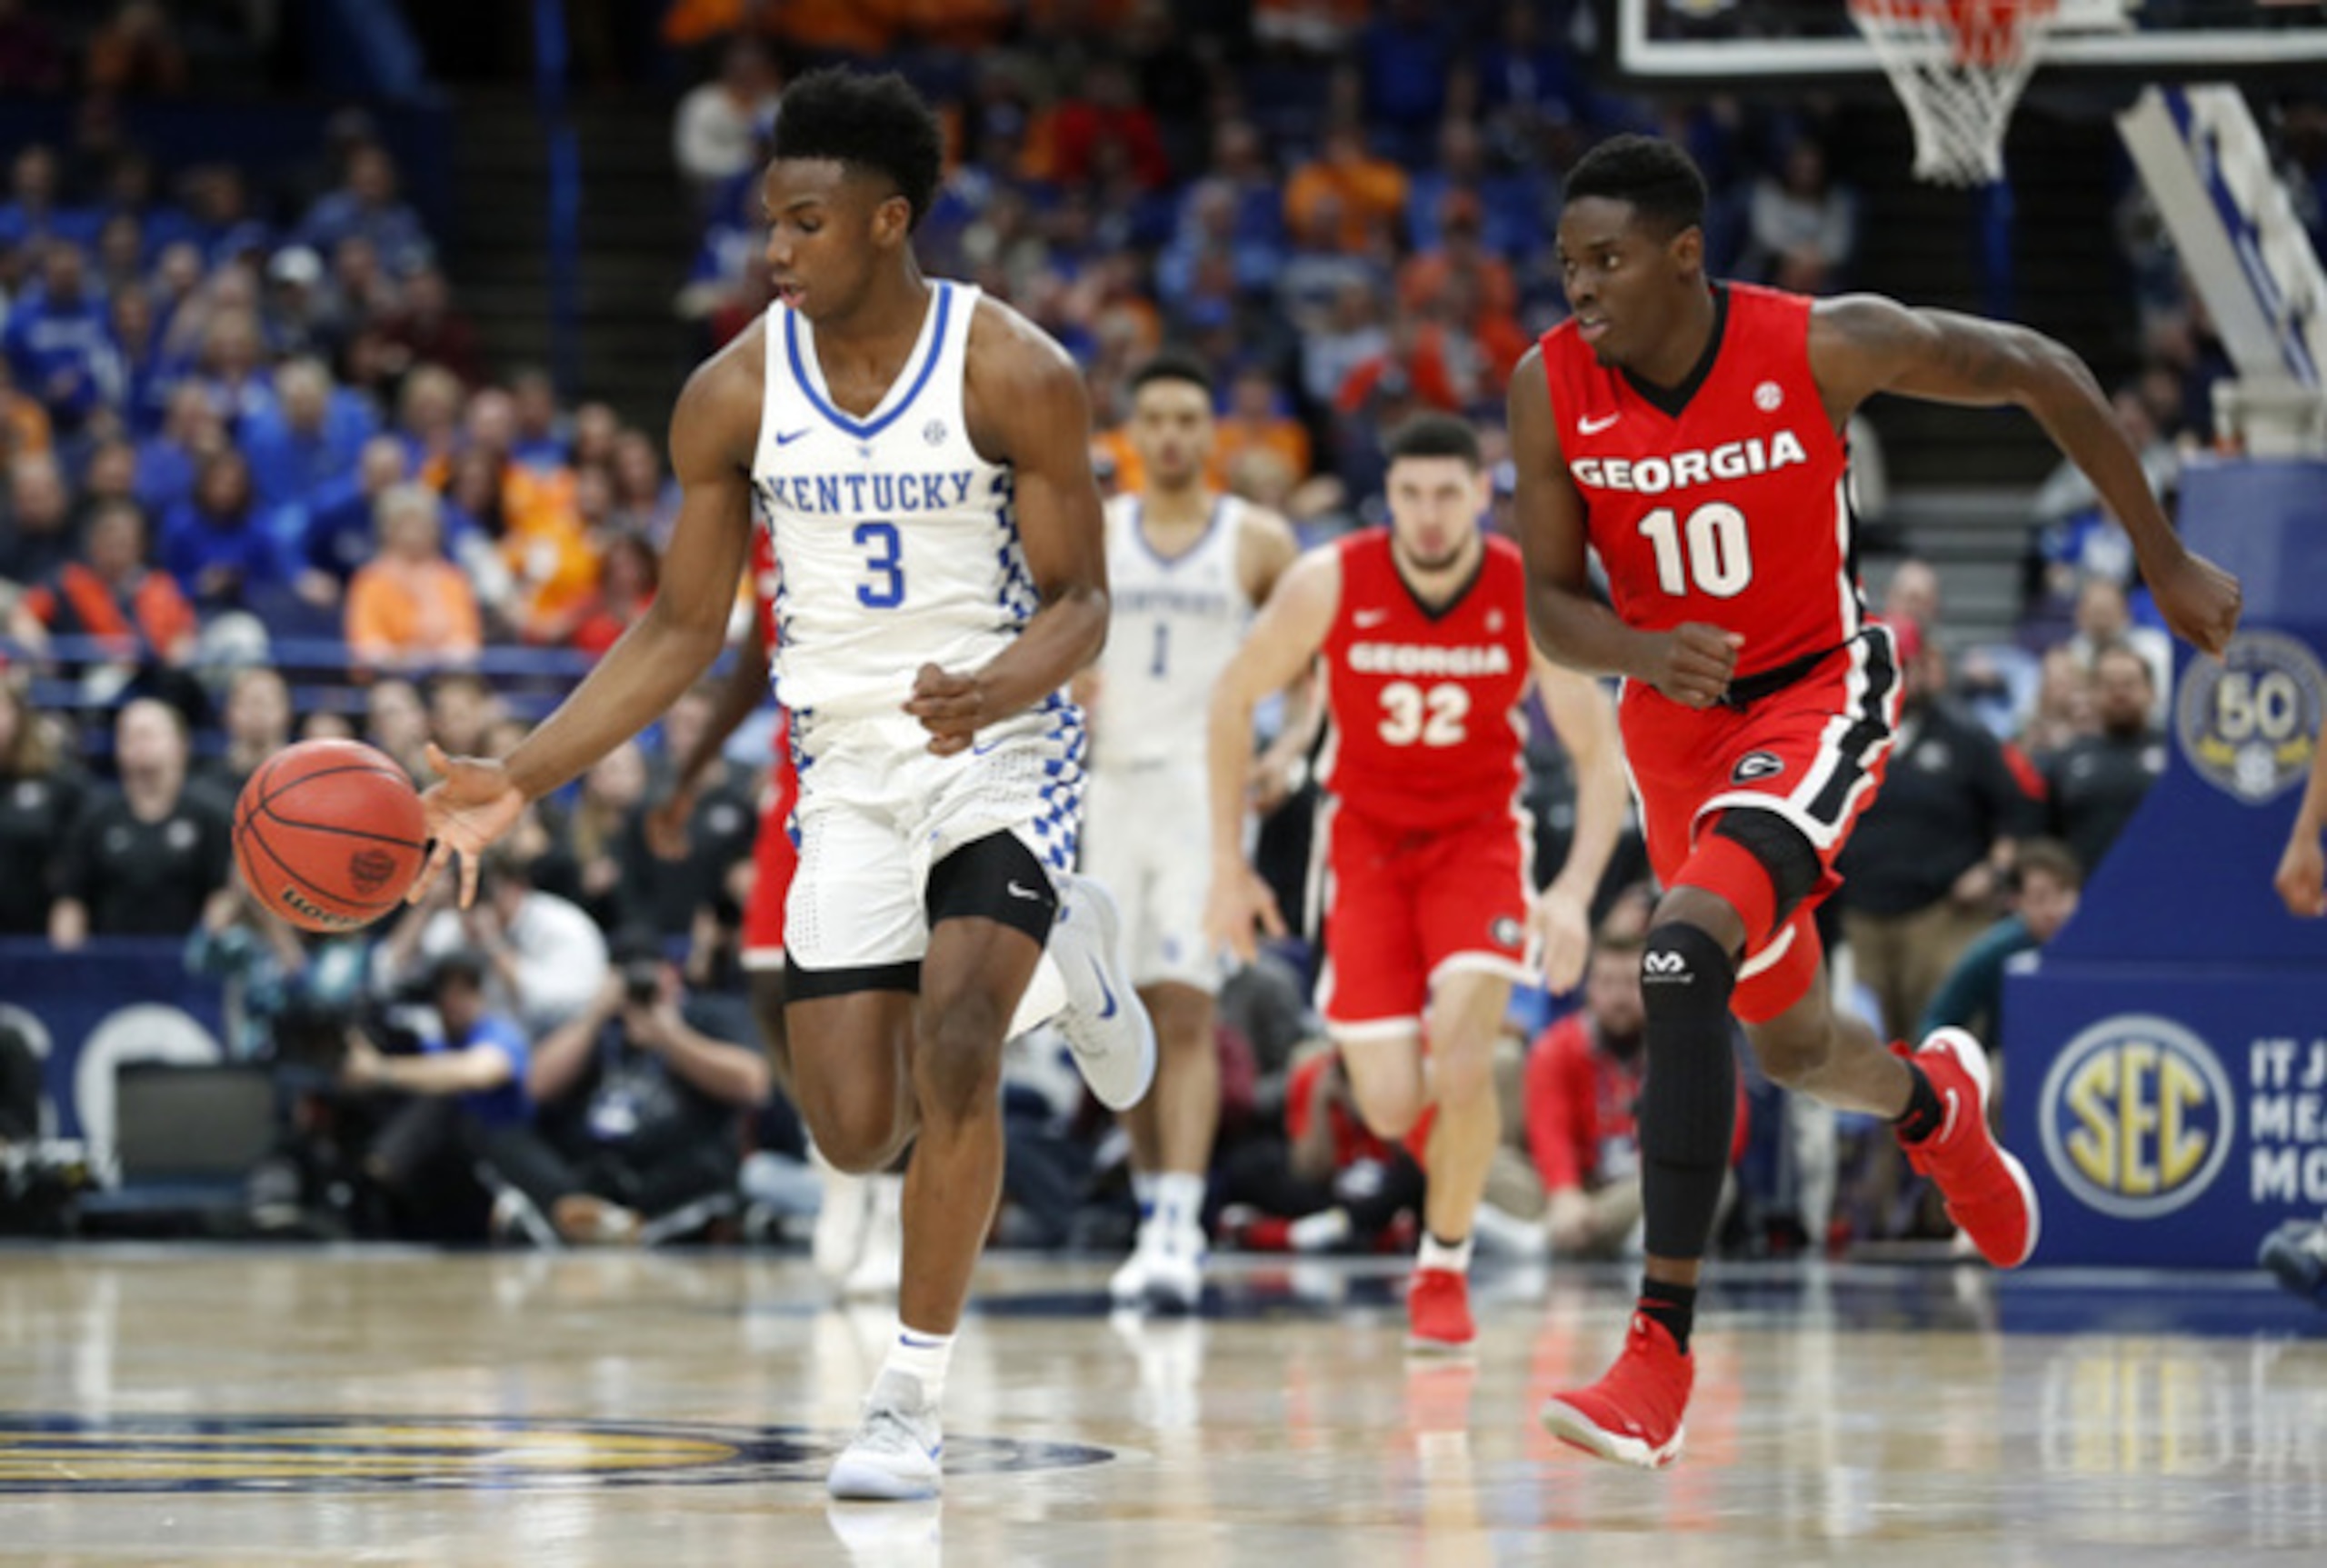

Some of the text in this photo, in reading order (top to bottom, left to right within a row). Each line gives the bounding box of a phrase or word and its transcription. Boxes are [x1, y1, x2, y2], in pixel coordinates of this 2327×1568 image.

[766, 470, 974, 514] KENTUCKY
[1570, 429, 1807, 494] GEORGIA
[853, 521, 905, 608] 3
[1638, 501, 1753, 598] 10
[1377, 680, 1470, 747] 32
[2218, 670, 2297, 740] 50
[2250, 1039, 2296, 1088] IT
[2064, 1040, 2209, 1195] SEC
[2250, 1093, 2327, 1140] ME
